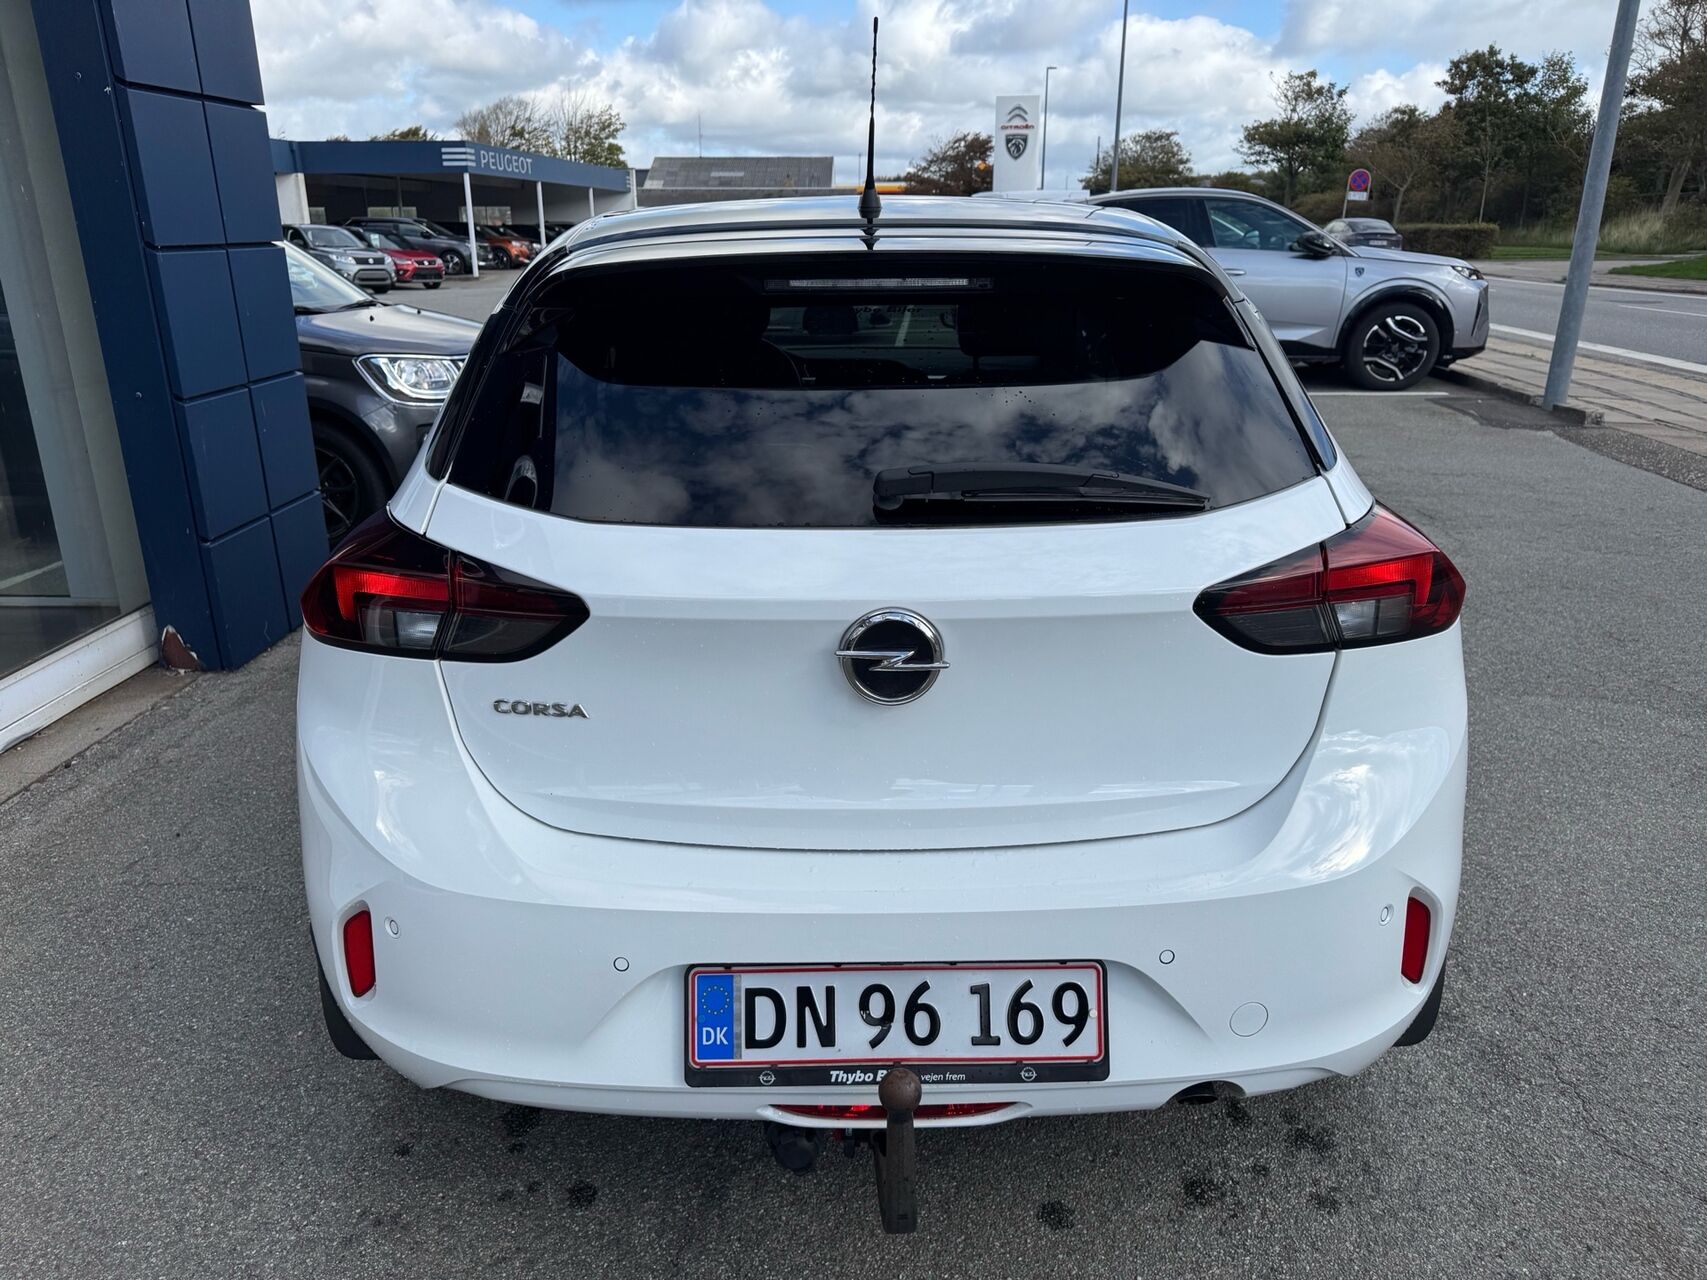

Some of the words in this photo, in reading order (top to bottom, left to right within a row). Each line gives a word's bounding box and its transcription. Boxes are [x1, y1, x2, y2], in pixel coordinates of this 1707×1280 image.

[480, 150, 532, 174] PEUGEOT
[493, 700, 590, 718] CORSA
[744, 985, 837, 1050] DN
[858, 979, 942, 1050] 96
[970, 979, 1090, 1048] 169
[702, 1026, 729, 1046] DK
[829, 1070, 874, 1084] Thybo
[920, 1072, 944, 1083] vejen
[945, 1071, 966, 1081] frem
